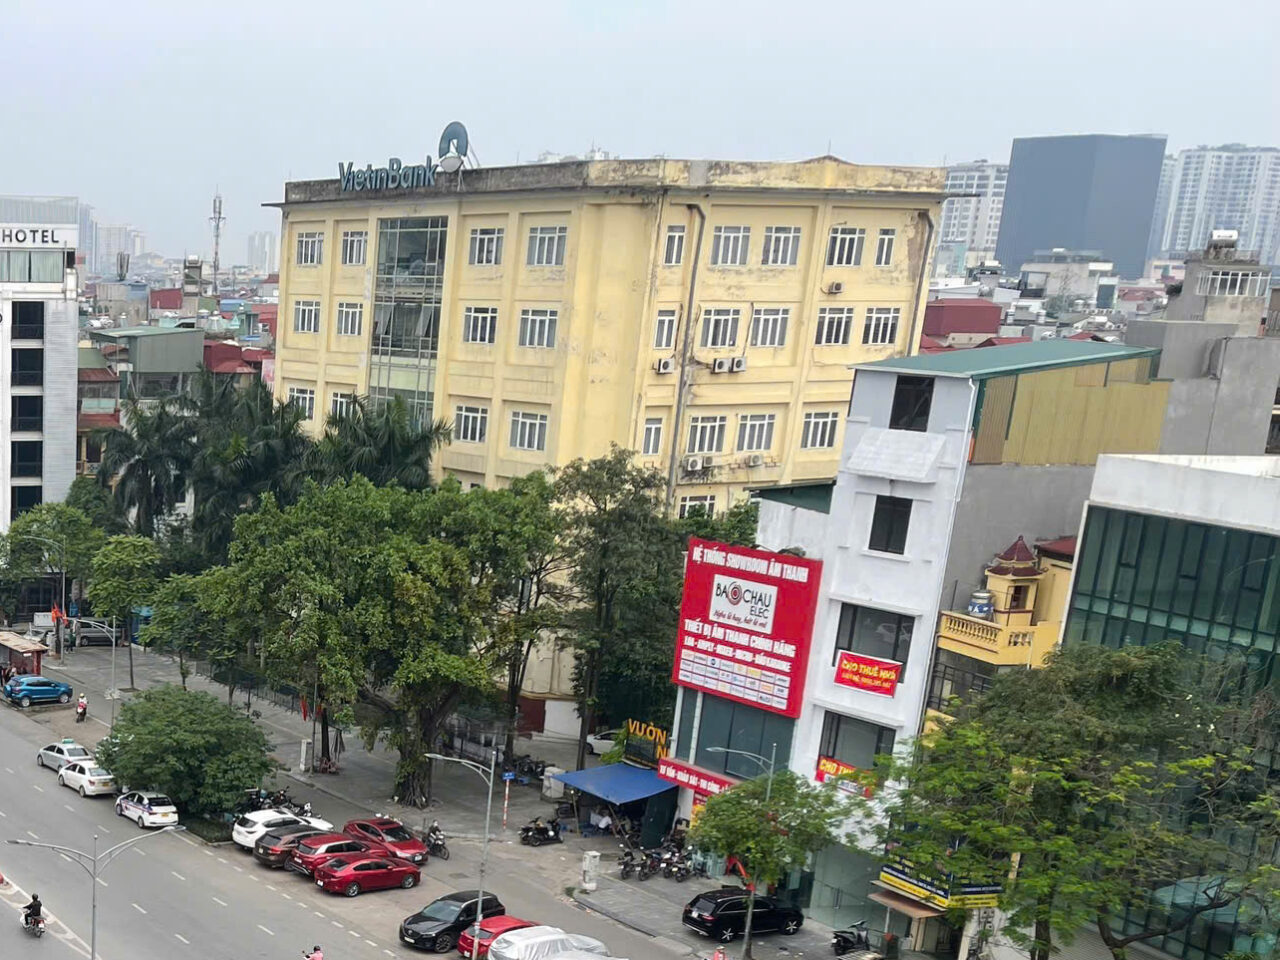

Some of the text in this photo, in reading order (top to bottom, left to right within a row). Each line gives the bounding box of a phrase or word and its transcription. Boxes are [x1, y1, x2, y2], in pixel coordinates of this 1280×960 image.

[339, 155, 439, 192] VietinBank
[2, 229, 60, 244] HOTEL
[704, 546, 726, 566] THỐNG
[782, 563, 809, 583] THANH
[750, 605, 770, 619] ELEC
[685, 618, 703, 634] THIẾT
[725, 629, 750, 646] THANH
[841, 660, 858, 672] CHO
[859, 664, 879, 677] THUÊ
[629, 718, 667, 745] VƯỜN
[819, 759, 838, 774] CHO
